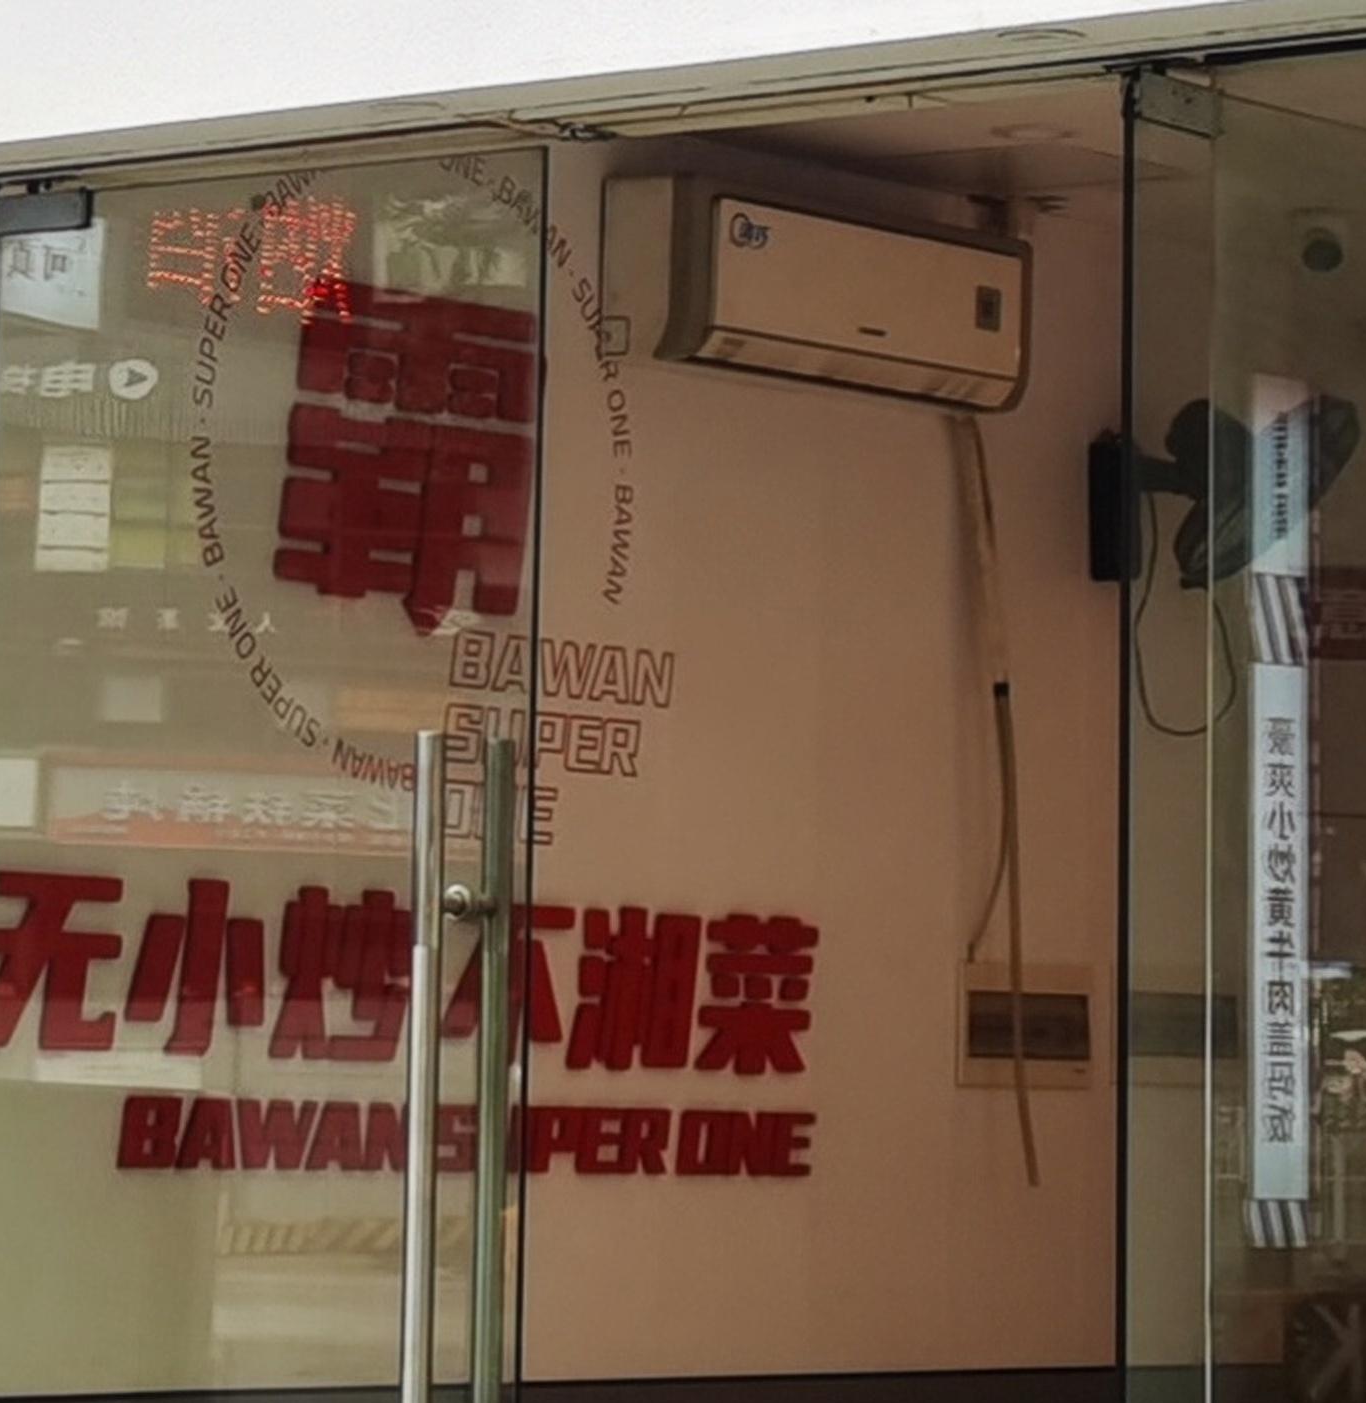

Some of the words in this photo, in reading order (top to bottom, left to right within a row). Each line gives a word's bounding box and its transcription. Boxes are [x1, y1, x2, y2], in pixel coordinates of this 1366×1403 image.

[192, 292, 234, 409] SUPER
[606, 389, 633, 459] ONE
[190, 436, 225, 568] BAWAN
[602, 484, 634, 606] BAWAN
[215, 586, 257, 661] ONE
[249, 655, 320, 748] SUPER
[449, 629, 676, 709] BAWAN
[116, 1093, 411, 1173] BAWAN
[674, 1109, 818, 1177] ONE
